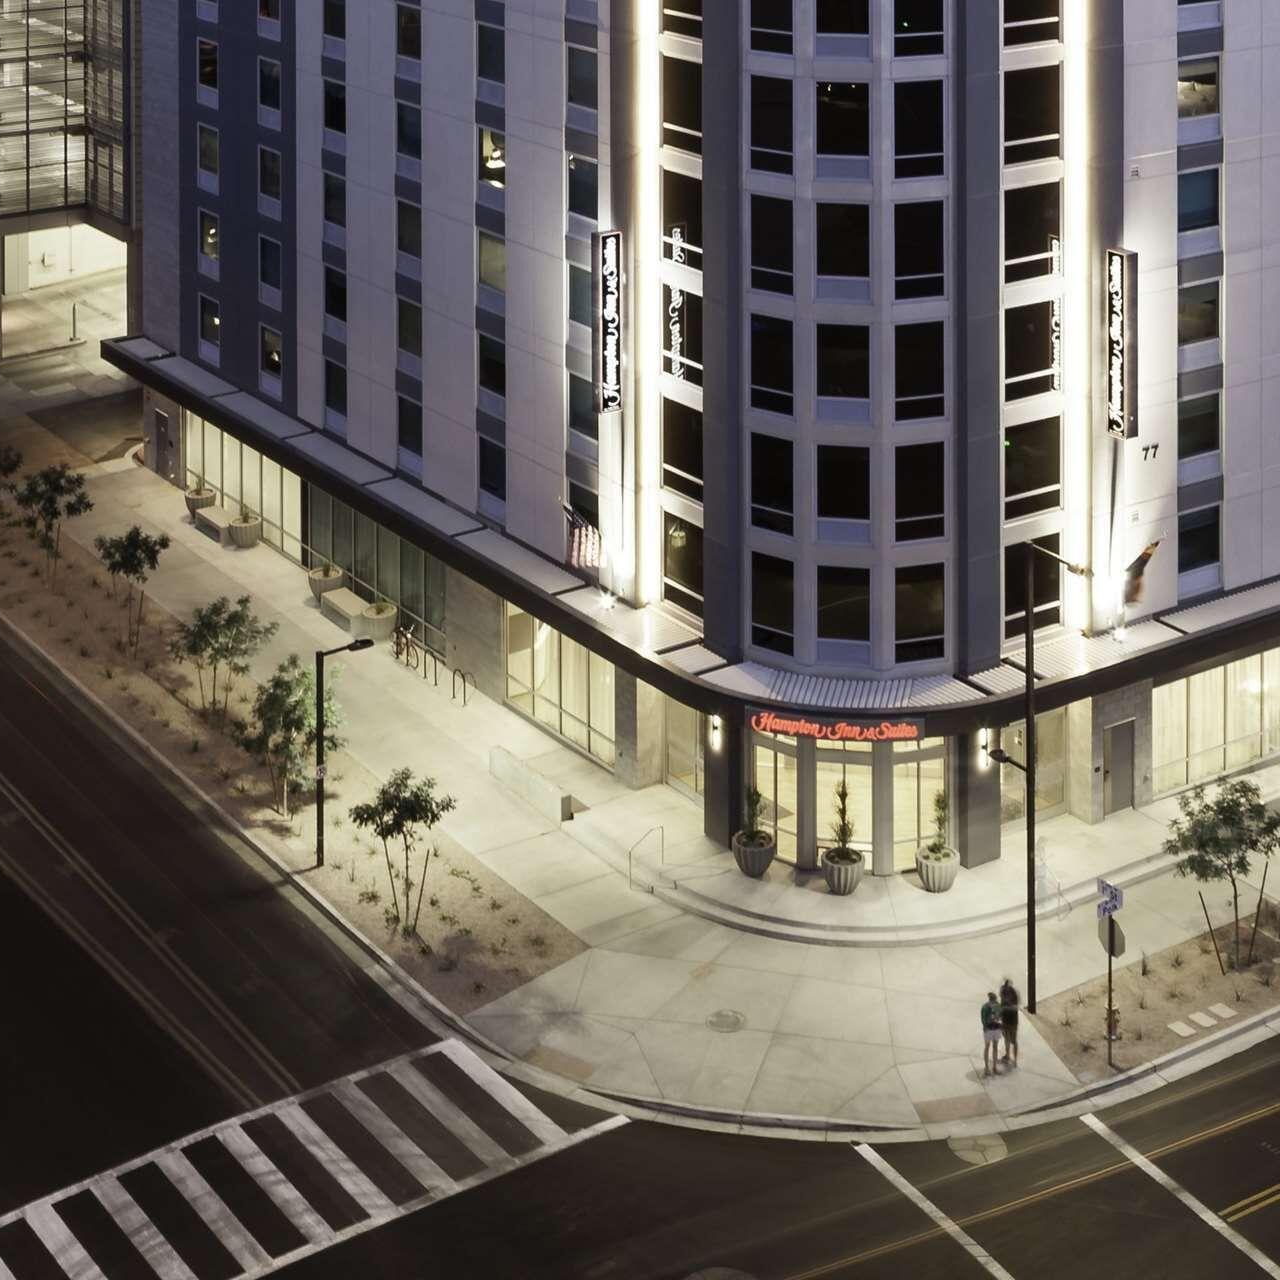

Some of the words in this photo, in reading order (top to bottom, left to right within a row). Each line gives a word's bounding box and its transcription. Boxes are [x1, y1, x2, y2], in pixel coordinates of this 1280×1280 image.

[602, 236, 618, 279] Suites
[602, 287, 619, 328] Inn
[602, 328, 620, 408] Hampton
[1108, 350, 1124, 432] Hampton
[1142, 443, 1159, 461] 77
[751, 712, 827, 738] Hampton
[827, 721, 867, 740] Inn
[875, 721, 919, 740] Suites
